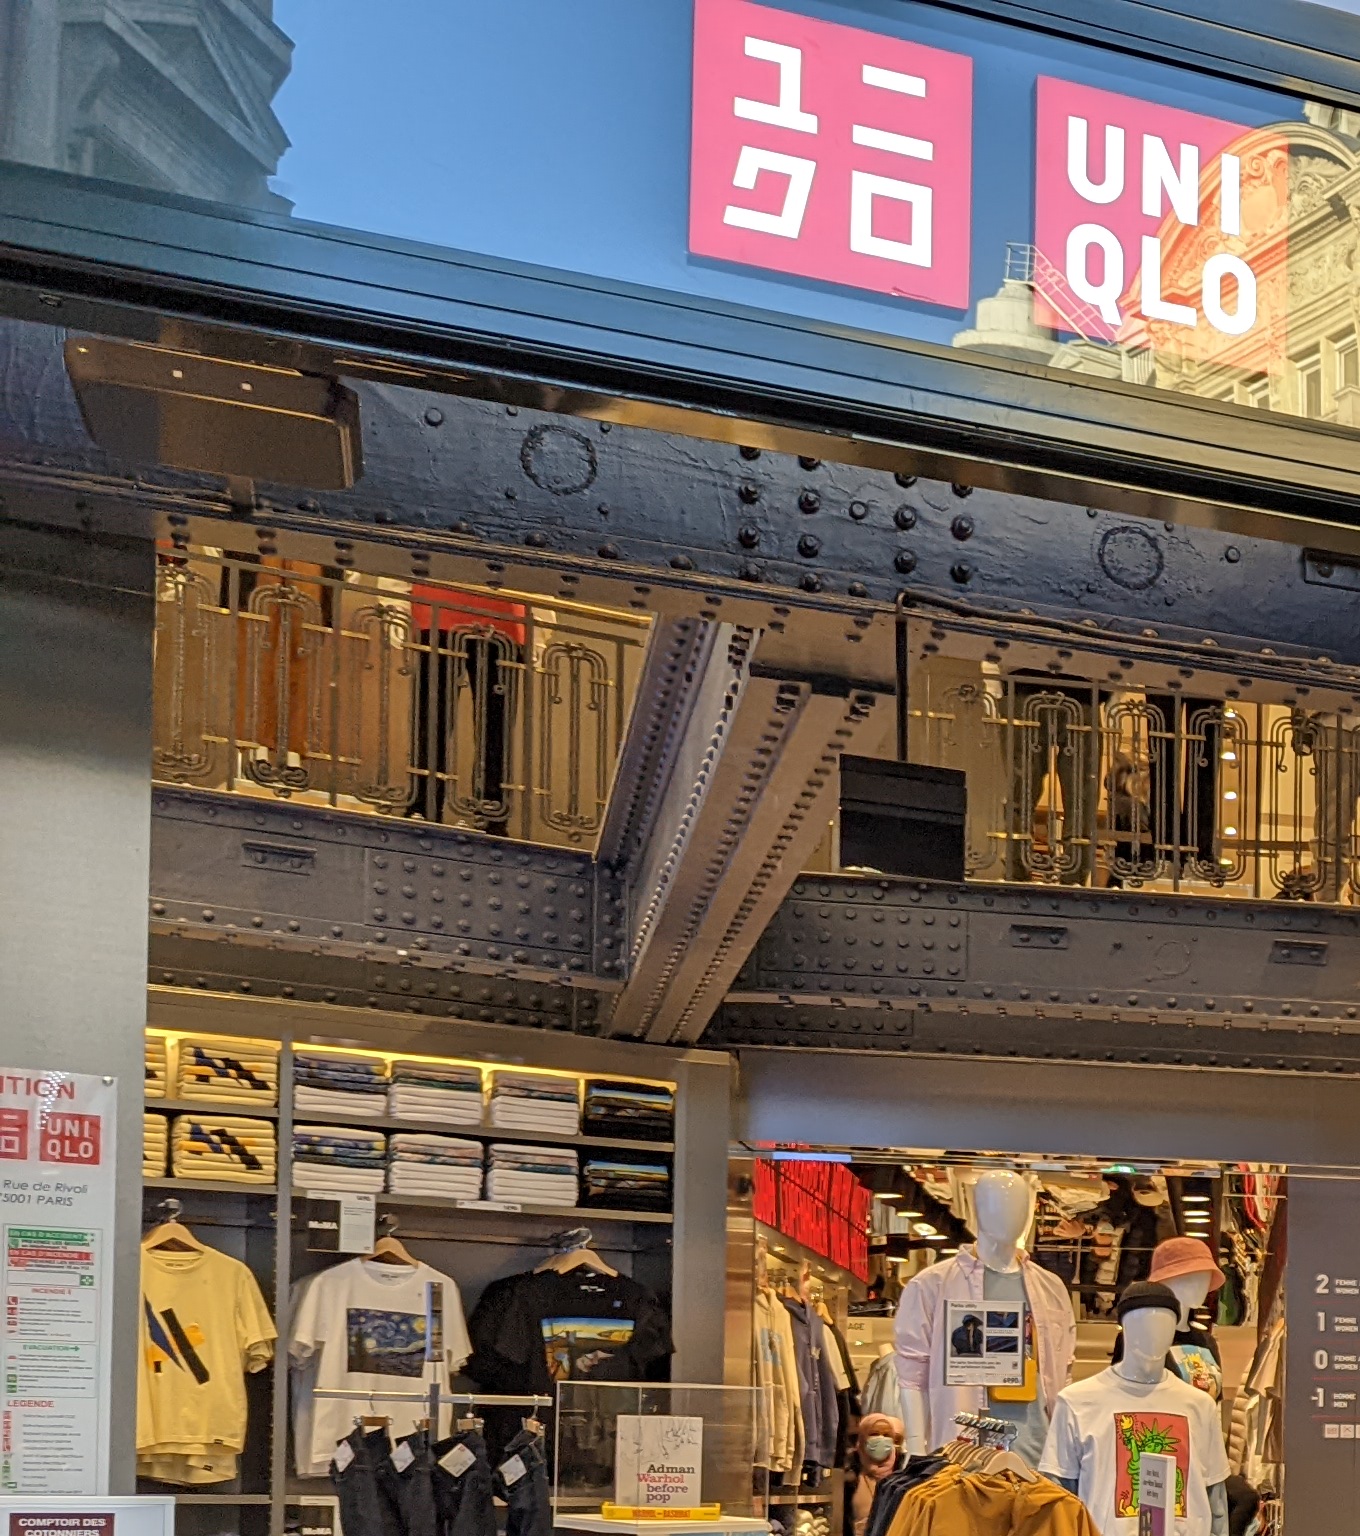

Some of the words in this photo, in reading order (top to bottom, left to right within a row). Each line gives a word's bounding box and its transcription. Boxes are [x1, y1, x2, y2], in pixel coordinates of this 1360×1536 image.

[1066, 115, 1241, 236] UNI
[1066, 222, 1258, 335] QLO
[0, 1075, 75, 1100] TION
[47, 1119, 93, 1139] UNI
[47, 1139, 94, 1159] QLO
[4, 1180, 29, 1190] Rue
[33, 1181, 51, 1192] de
[55, 1183, 88, 1194] Rivoli
[37, 1195, 73, 1207] PARIS
[1316, 1274, 1329, 1294] 2
[1317, 1311, 1326, 1332] 1
[1315, 1349, 1328, 1370] 0
[7, 1400, 54, 1408] LEGENDE
[1311, 1387, 1324, 1408] -1
[637, 1474, 685, 1484] Warhol
[646, 1464, 695, 1474] Adman
[646, 1484, 688, 1493] before
[646, 1494, 671, 1503] pop
[18, 1518, 80, 1527] COMPTOIR
[82, 1518, 107, 1527] DES
